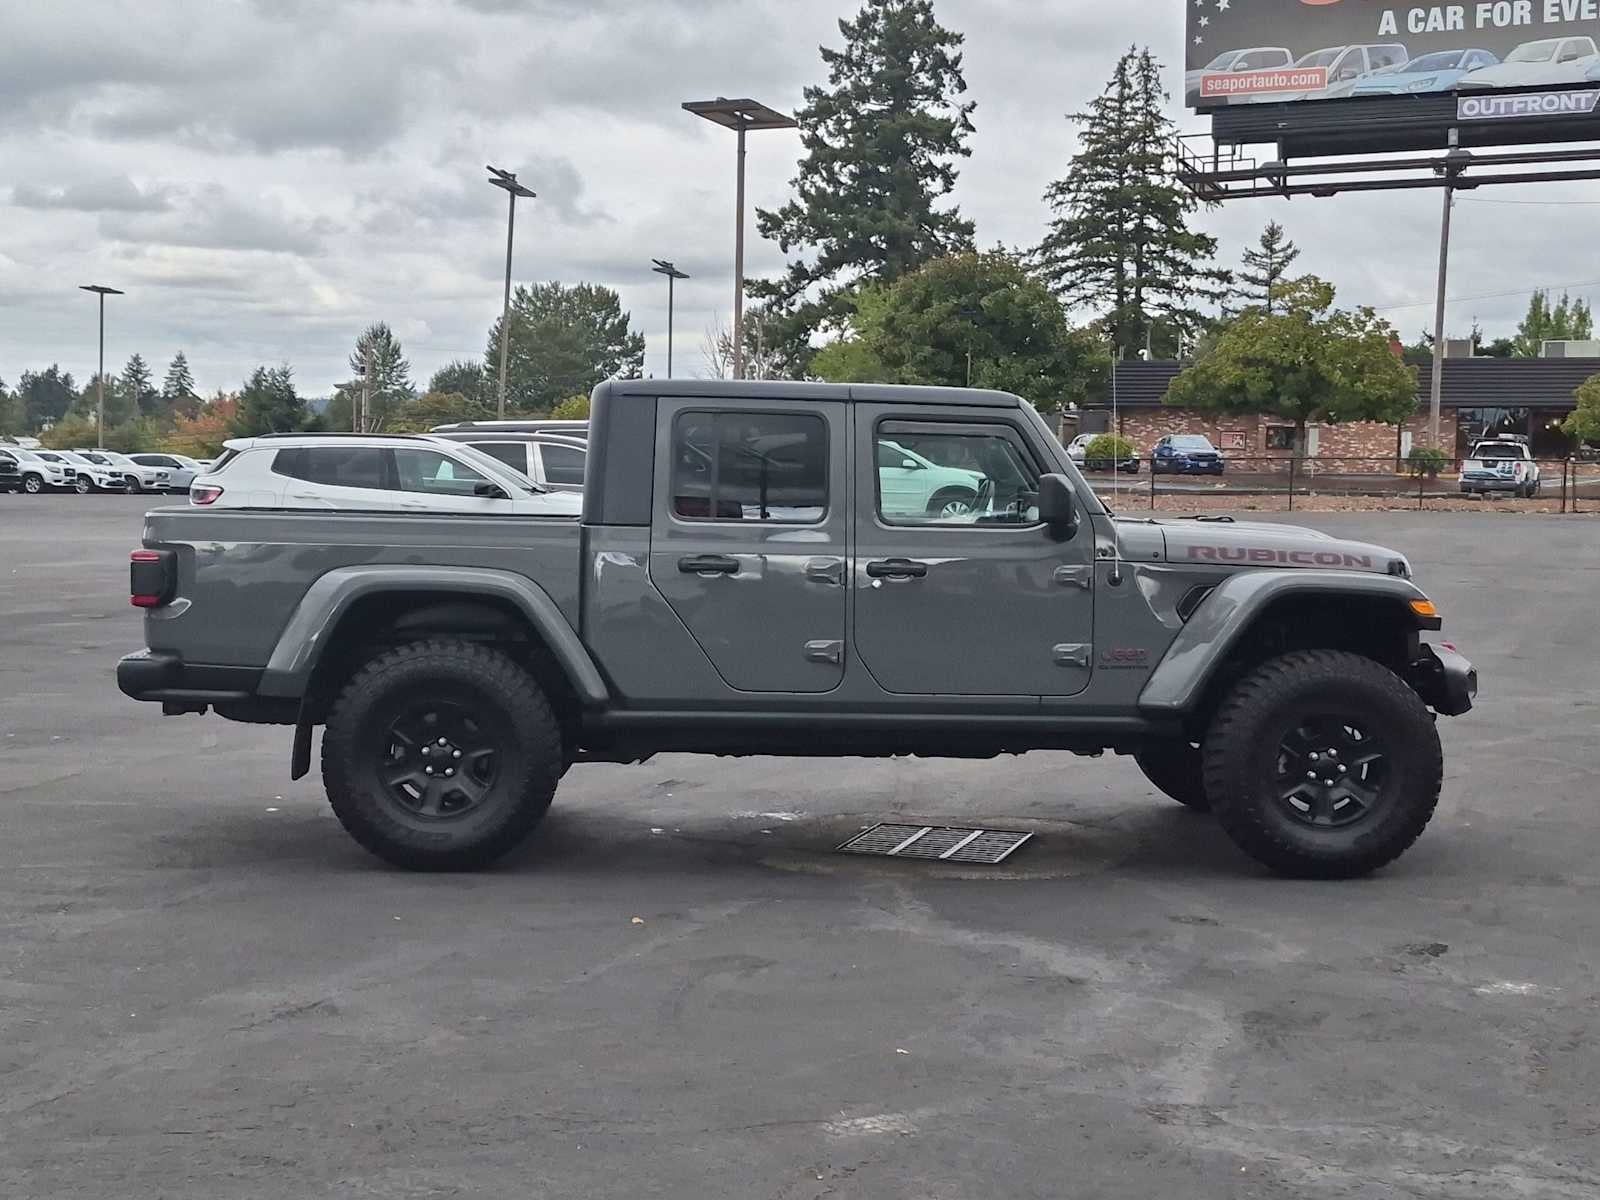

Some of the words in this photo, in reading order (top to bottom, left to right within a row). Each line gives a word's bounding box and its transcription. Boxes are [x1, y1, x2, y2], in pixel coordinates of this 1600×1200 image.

[1377, 10, 1399, 36] A
[1407, 5, 1465, 34] CAR
[1475, 0, 1532, 29] FOR
[1543, 0, 1600, 23] EVE
[1206, 72, 1321, 92] seaportauto.com
[1462, 93, 1594, 116] OUTFRONT
[1187, 545, 1372, 568] RUBICON
